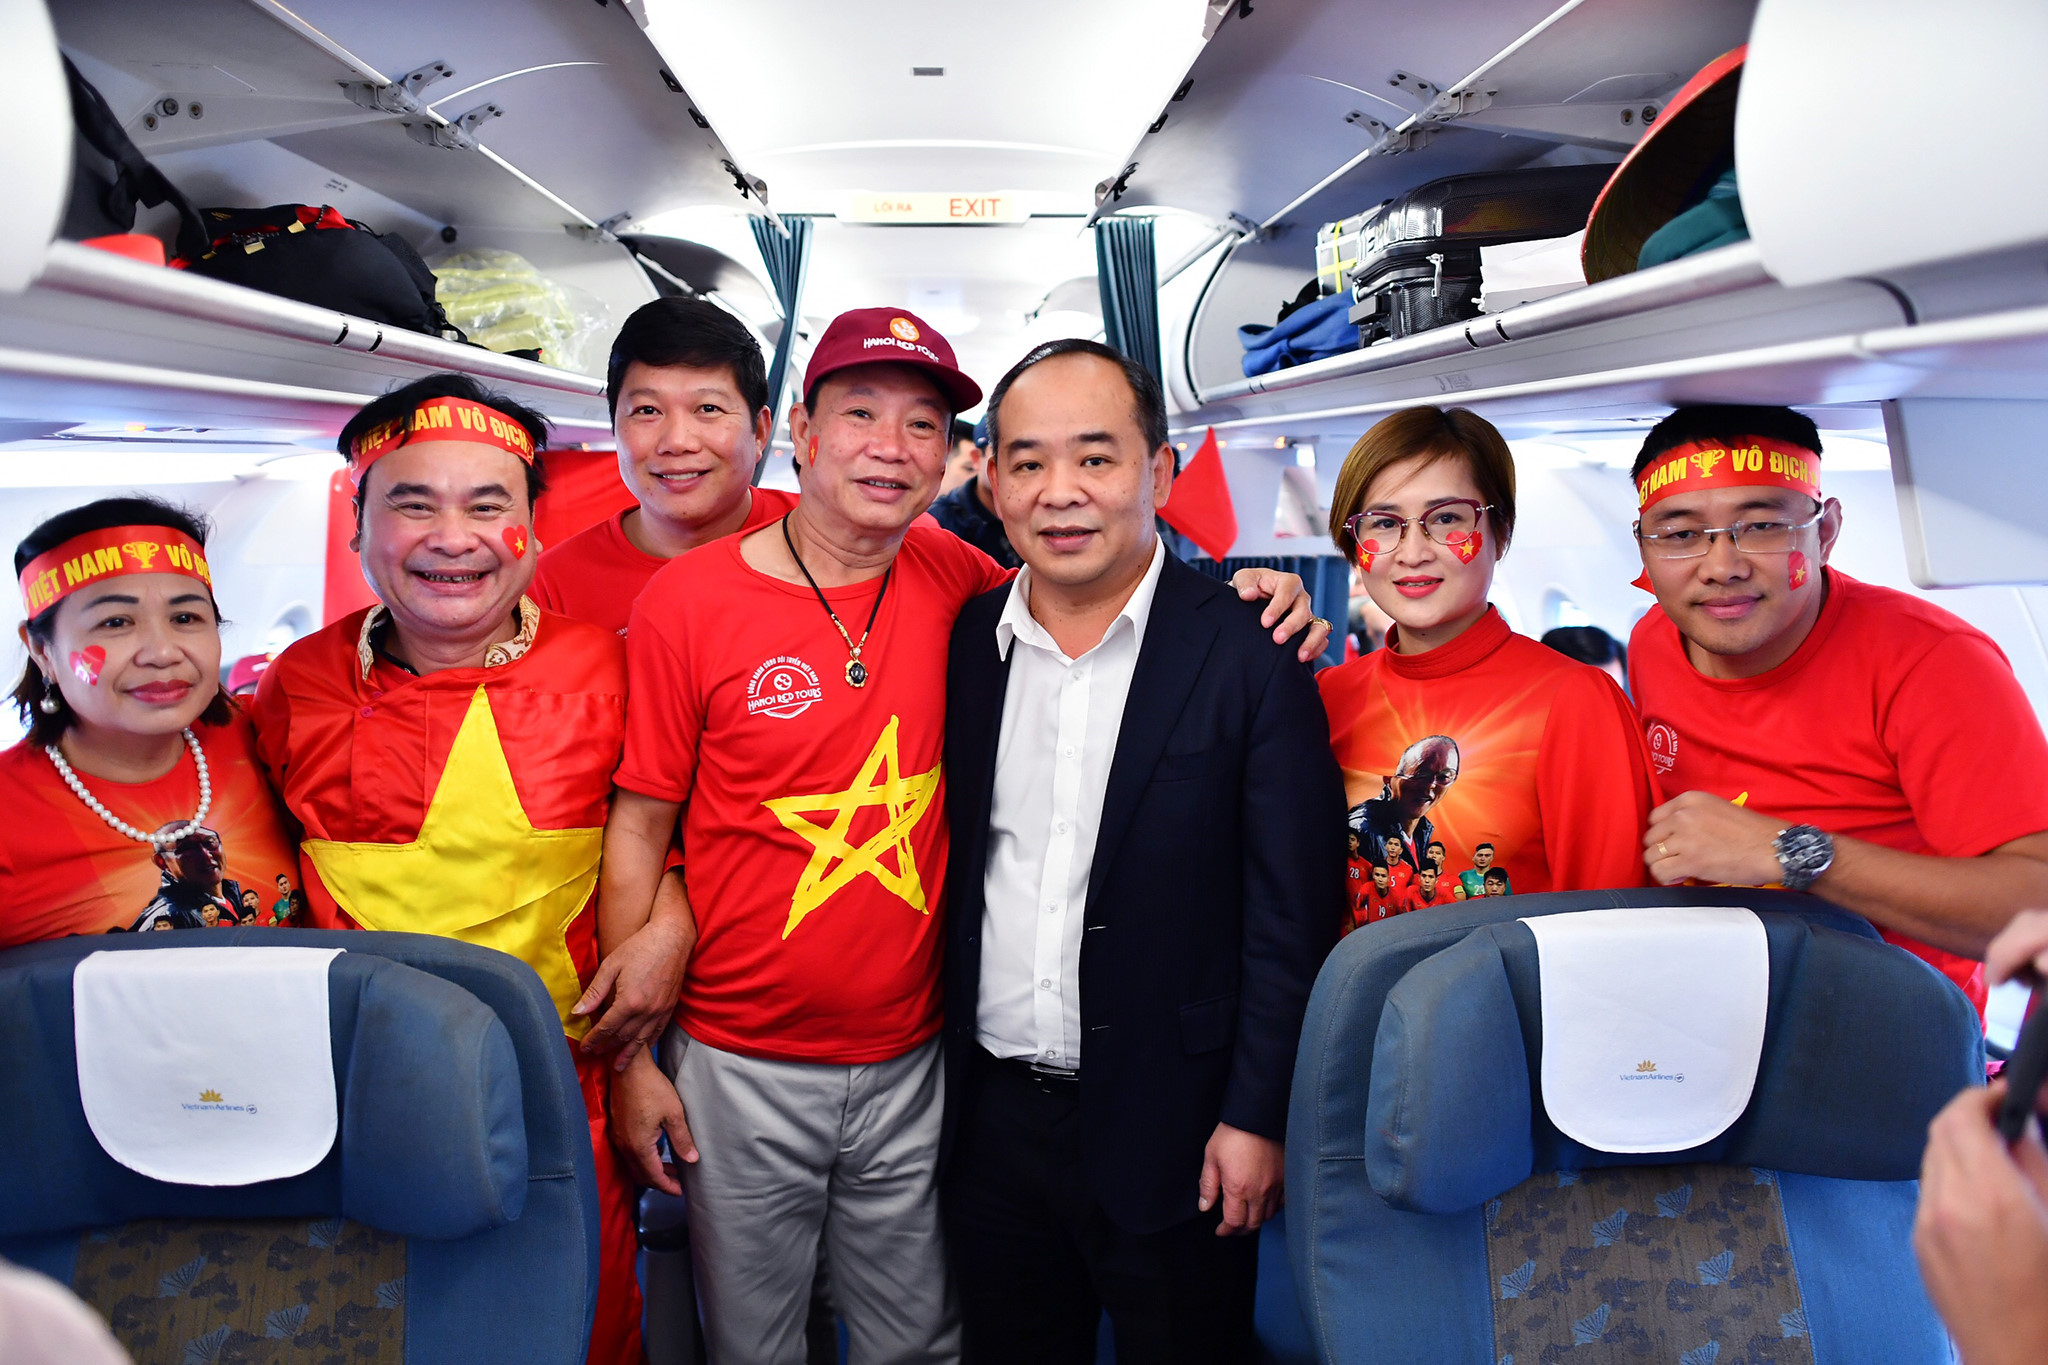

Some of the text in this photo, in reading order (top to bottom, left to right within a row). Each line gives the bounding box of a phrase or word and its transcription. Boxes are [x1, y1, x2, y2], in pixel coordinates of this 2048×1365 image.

[950, 198, 1000, 217] EXIT
[864, 337, 896, 350] HANOI
[456, 407, 487, 432] VÔ
[489, 415, 528, 452] ĐỊCH
[1649, 457, 1687, 495] NAM
[1732, 445, 1763, 472] VÔ
[1769, 451, 1809, 483] ĐỊCH
[28, 567, 61, 608] VIỆT
[63, 547, 123, 586] NAM
[164, 543, 193, 571] VÔ
[747, 687, 822, 711] HANOI RED TOURS
[1350, 867, 1360, 879] 28
[1391, 875, 1397, 887] 5
[1378, 905, 1386, 918] 19
